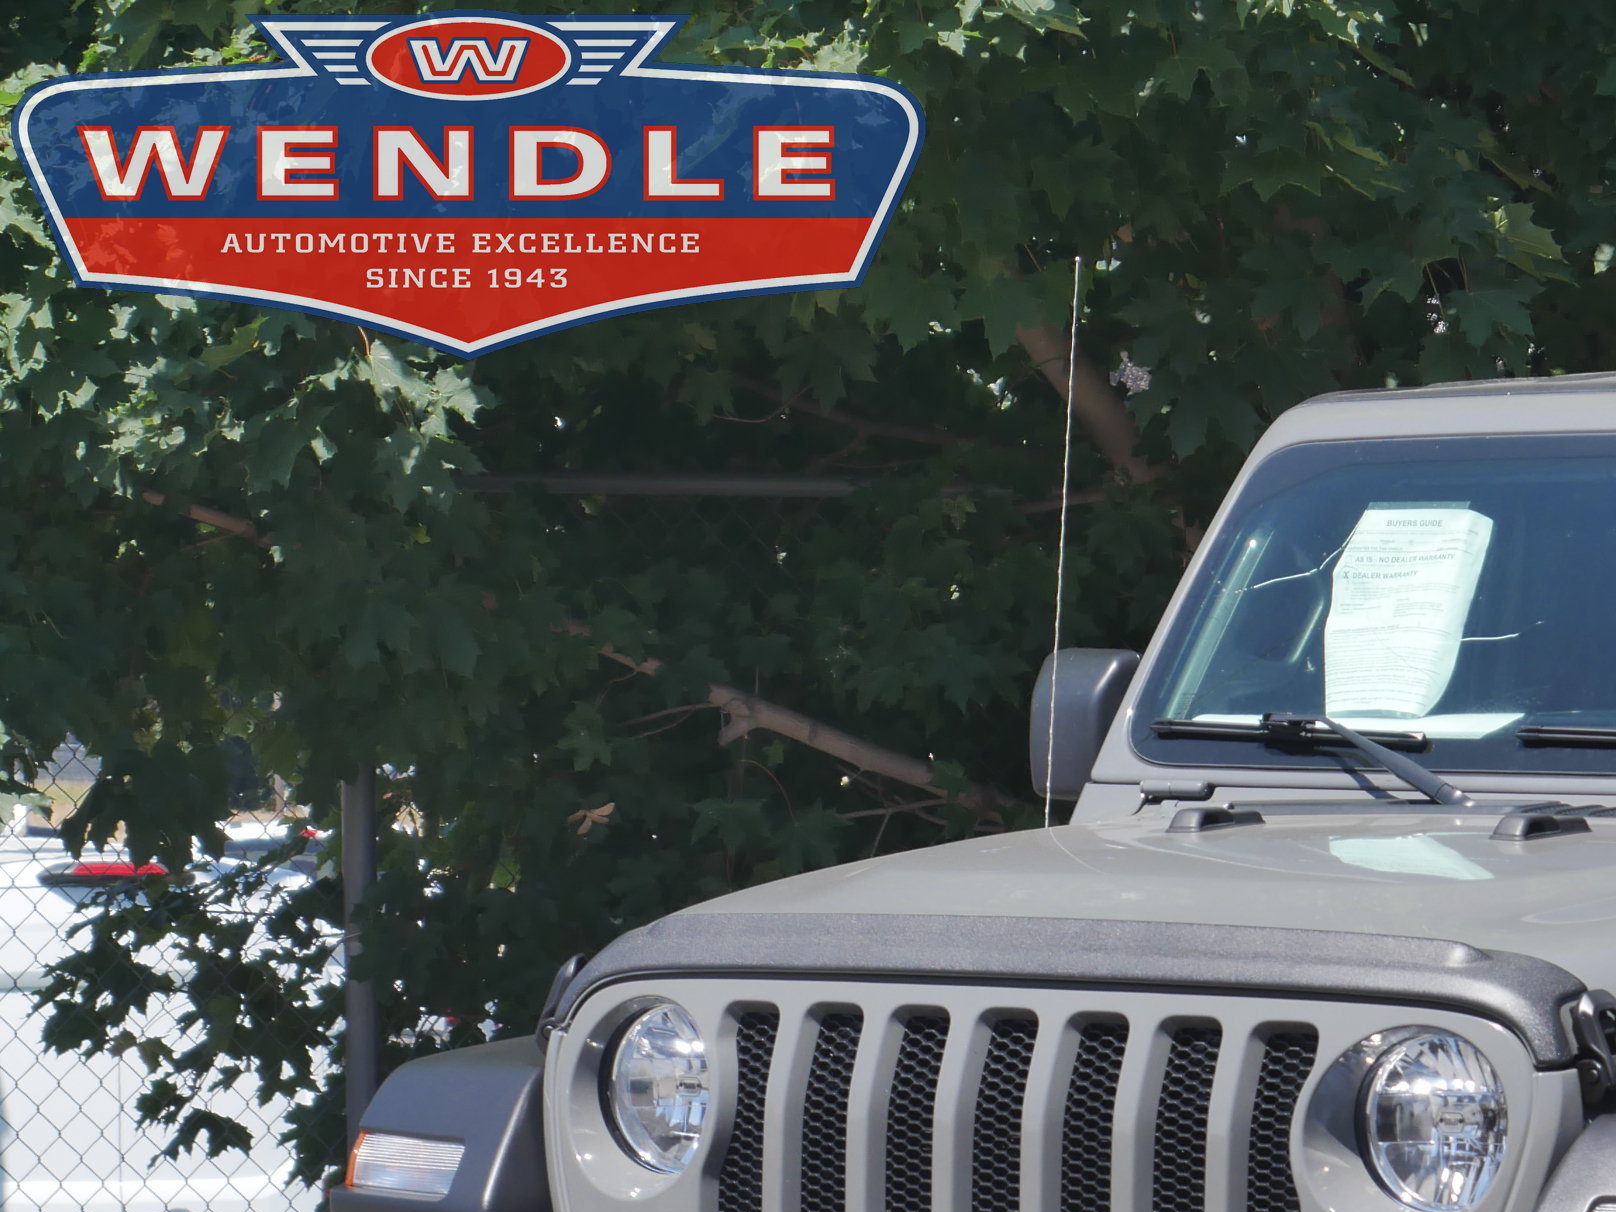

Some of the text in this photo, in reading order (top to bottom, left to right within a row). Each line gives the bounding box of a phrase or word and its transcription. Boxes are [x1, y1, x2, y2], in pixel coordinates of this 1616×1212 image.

[1387, 519, 1443, 528] BUYERS GUIDE
[1355, 556, 1364, 564] AS
[1379, 556, 1389, 564] NO
[1390, 555, 1417, 564] DEALER
[1418, 553, 1456, 562] WARRANTY
[1352, 571, 1381, 580] DEALER
[1382, 570, 1418, 580] WARRANTY
